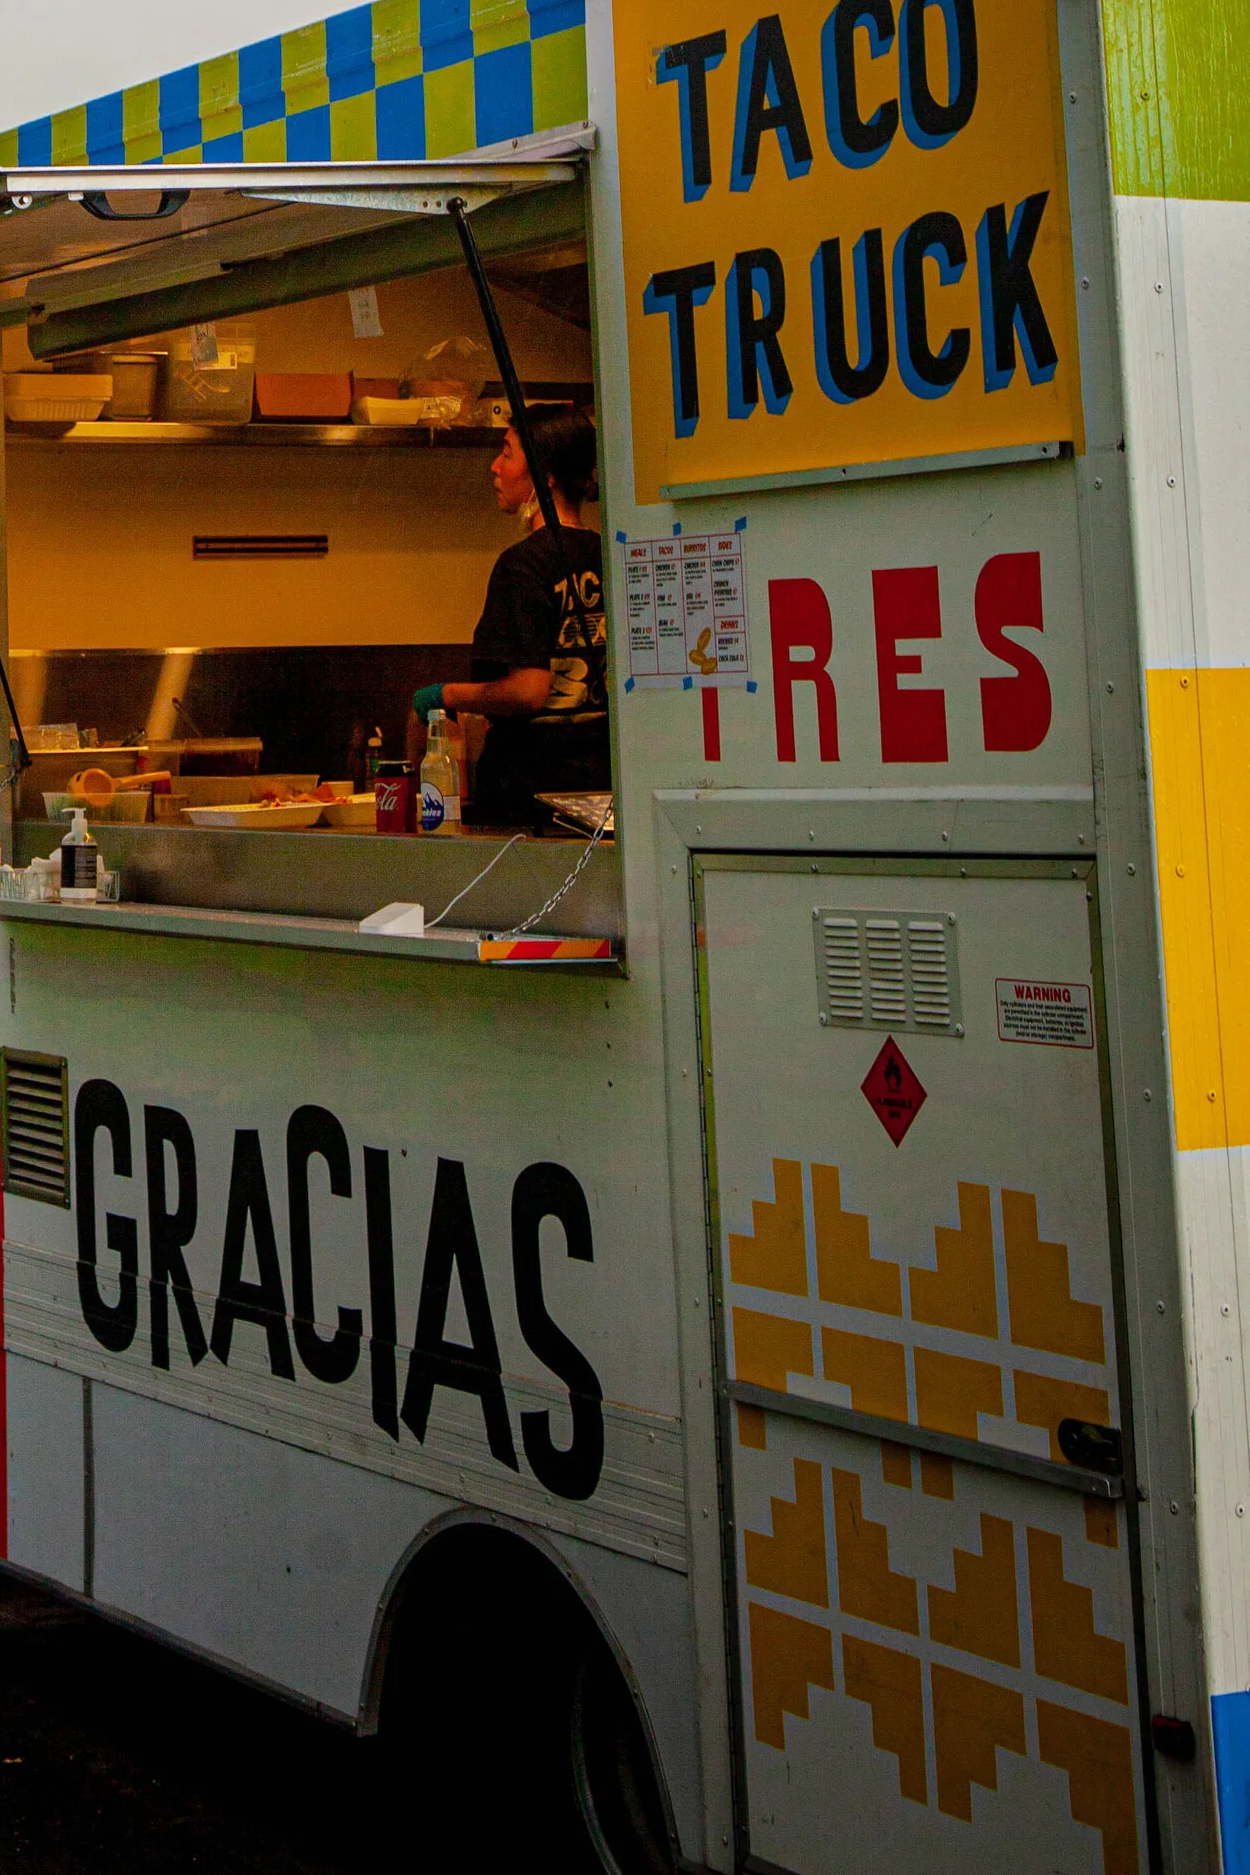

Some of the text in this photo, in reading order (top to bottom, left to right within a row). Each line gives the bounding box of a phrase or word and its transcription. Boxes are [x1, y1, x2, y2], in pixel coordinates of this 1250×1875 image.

[642, 189, 1059, 439] TRUCK
[1014, 984, 1072, 1003] WARNING
[73, 1077, 605, 1501] GRACIAS
